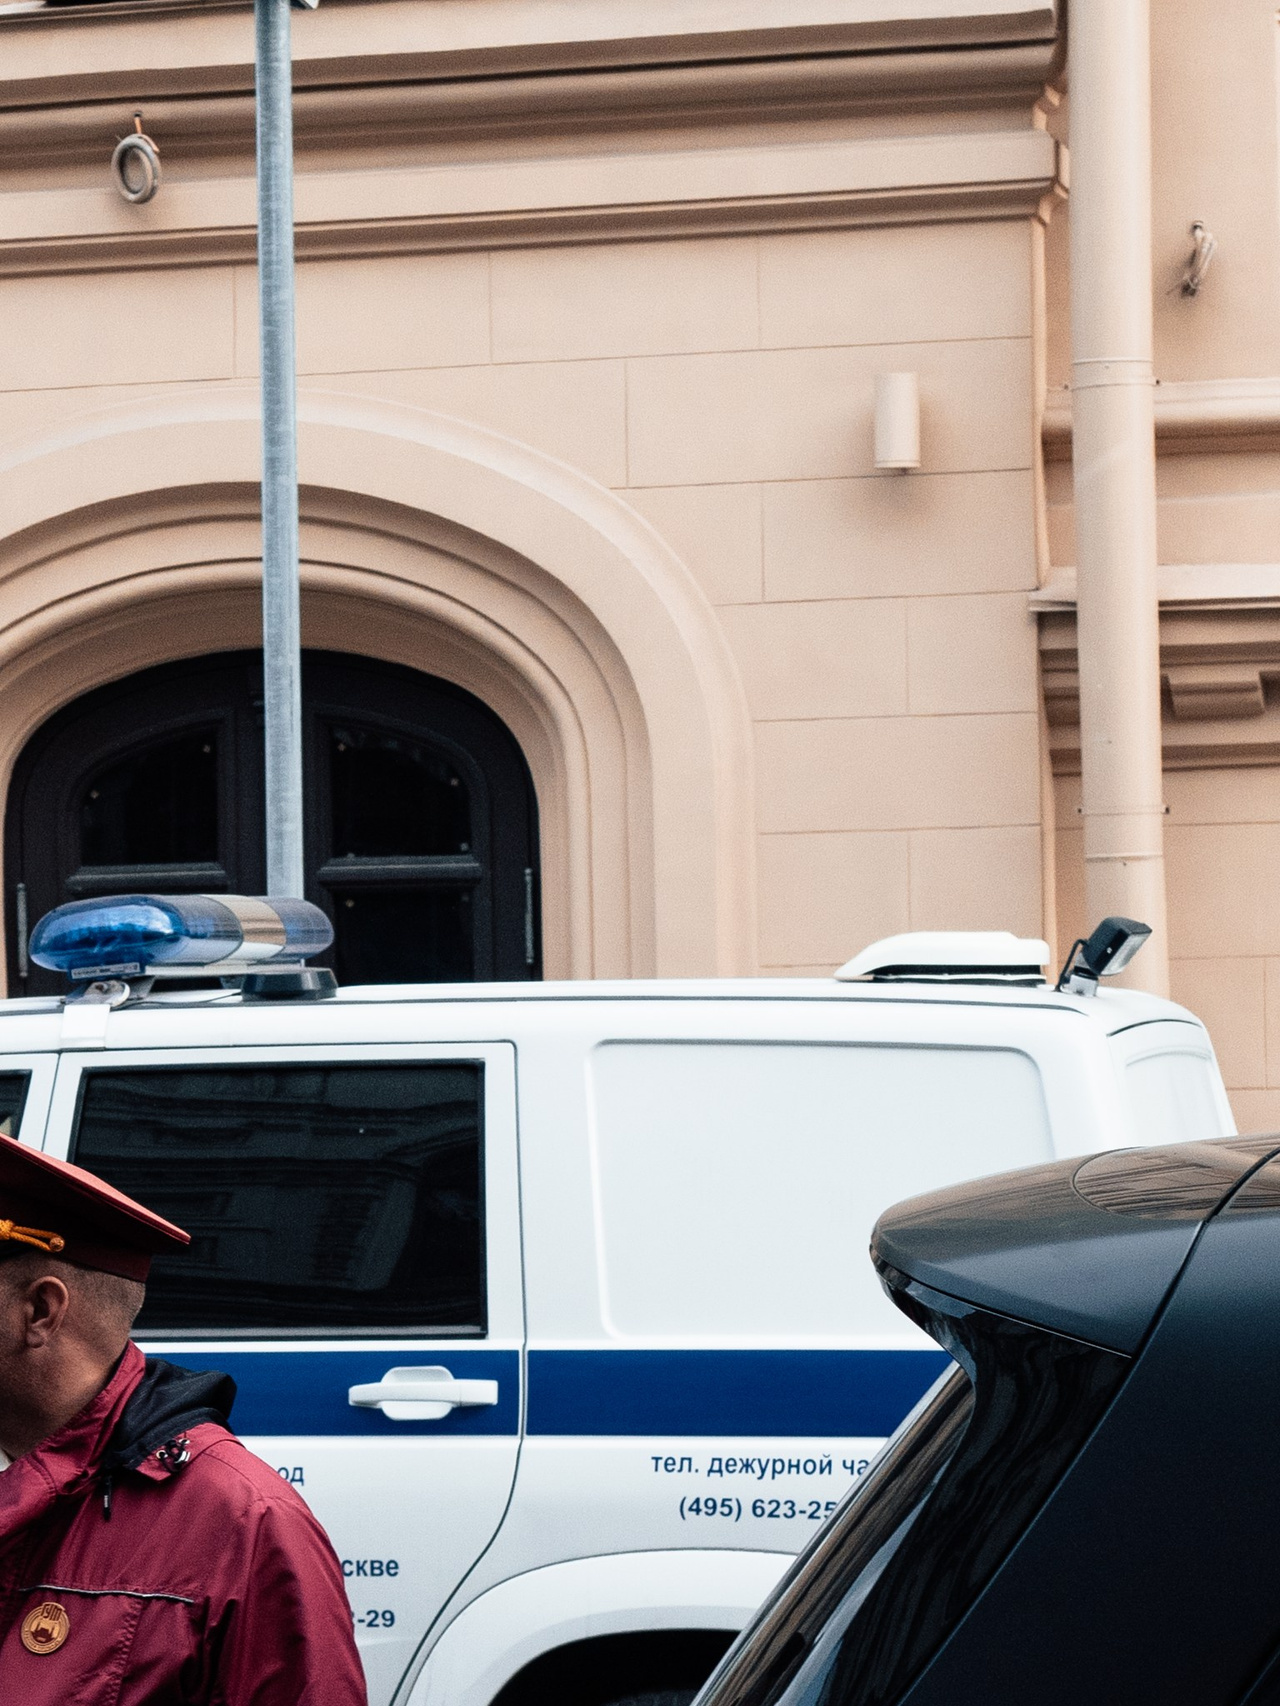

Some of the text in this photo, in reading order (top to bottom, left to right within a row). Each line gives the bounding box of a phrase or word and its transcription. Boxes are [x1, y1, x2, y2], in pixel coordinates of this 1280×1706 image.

[651, 1455, 699, 1473] тел.
[707, 1453, 833, 1480] дежурной
[679, 1496, 742, 1522] (495)
[351, 1609, 396, 1628] -29
